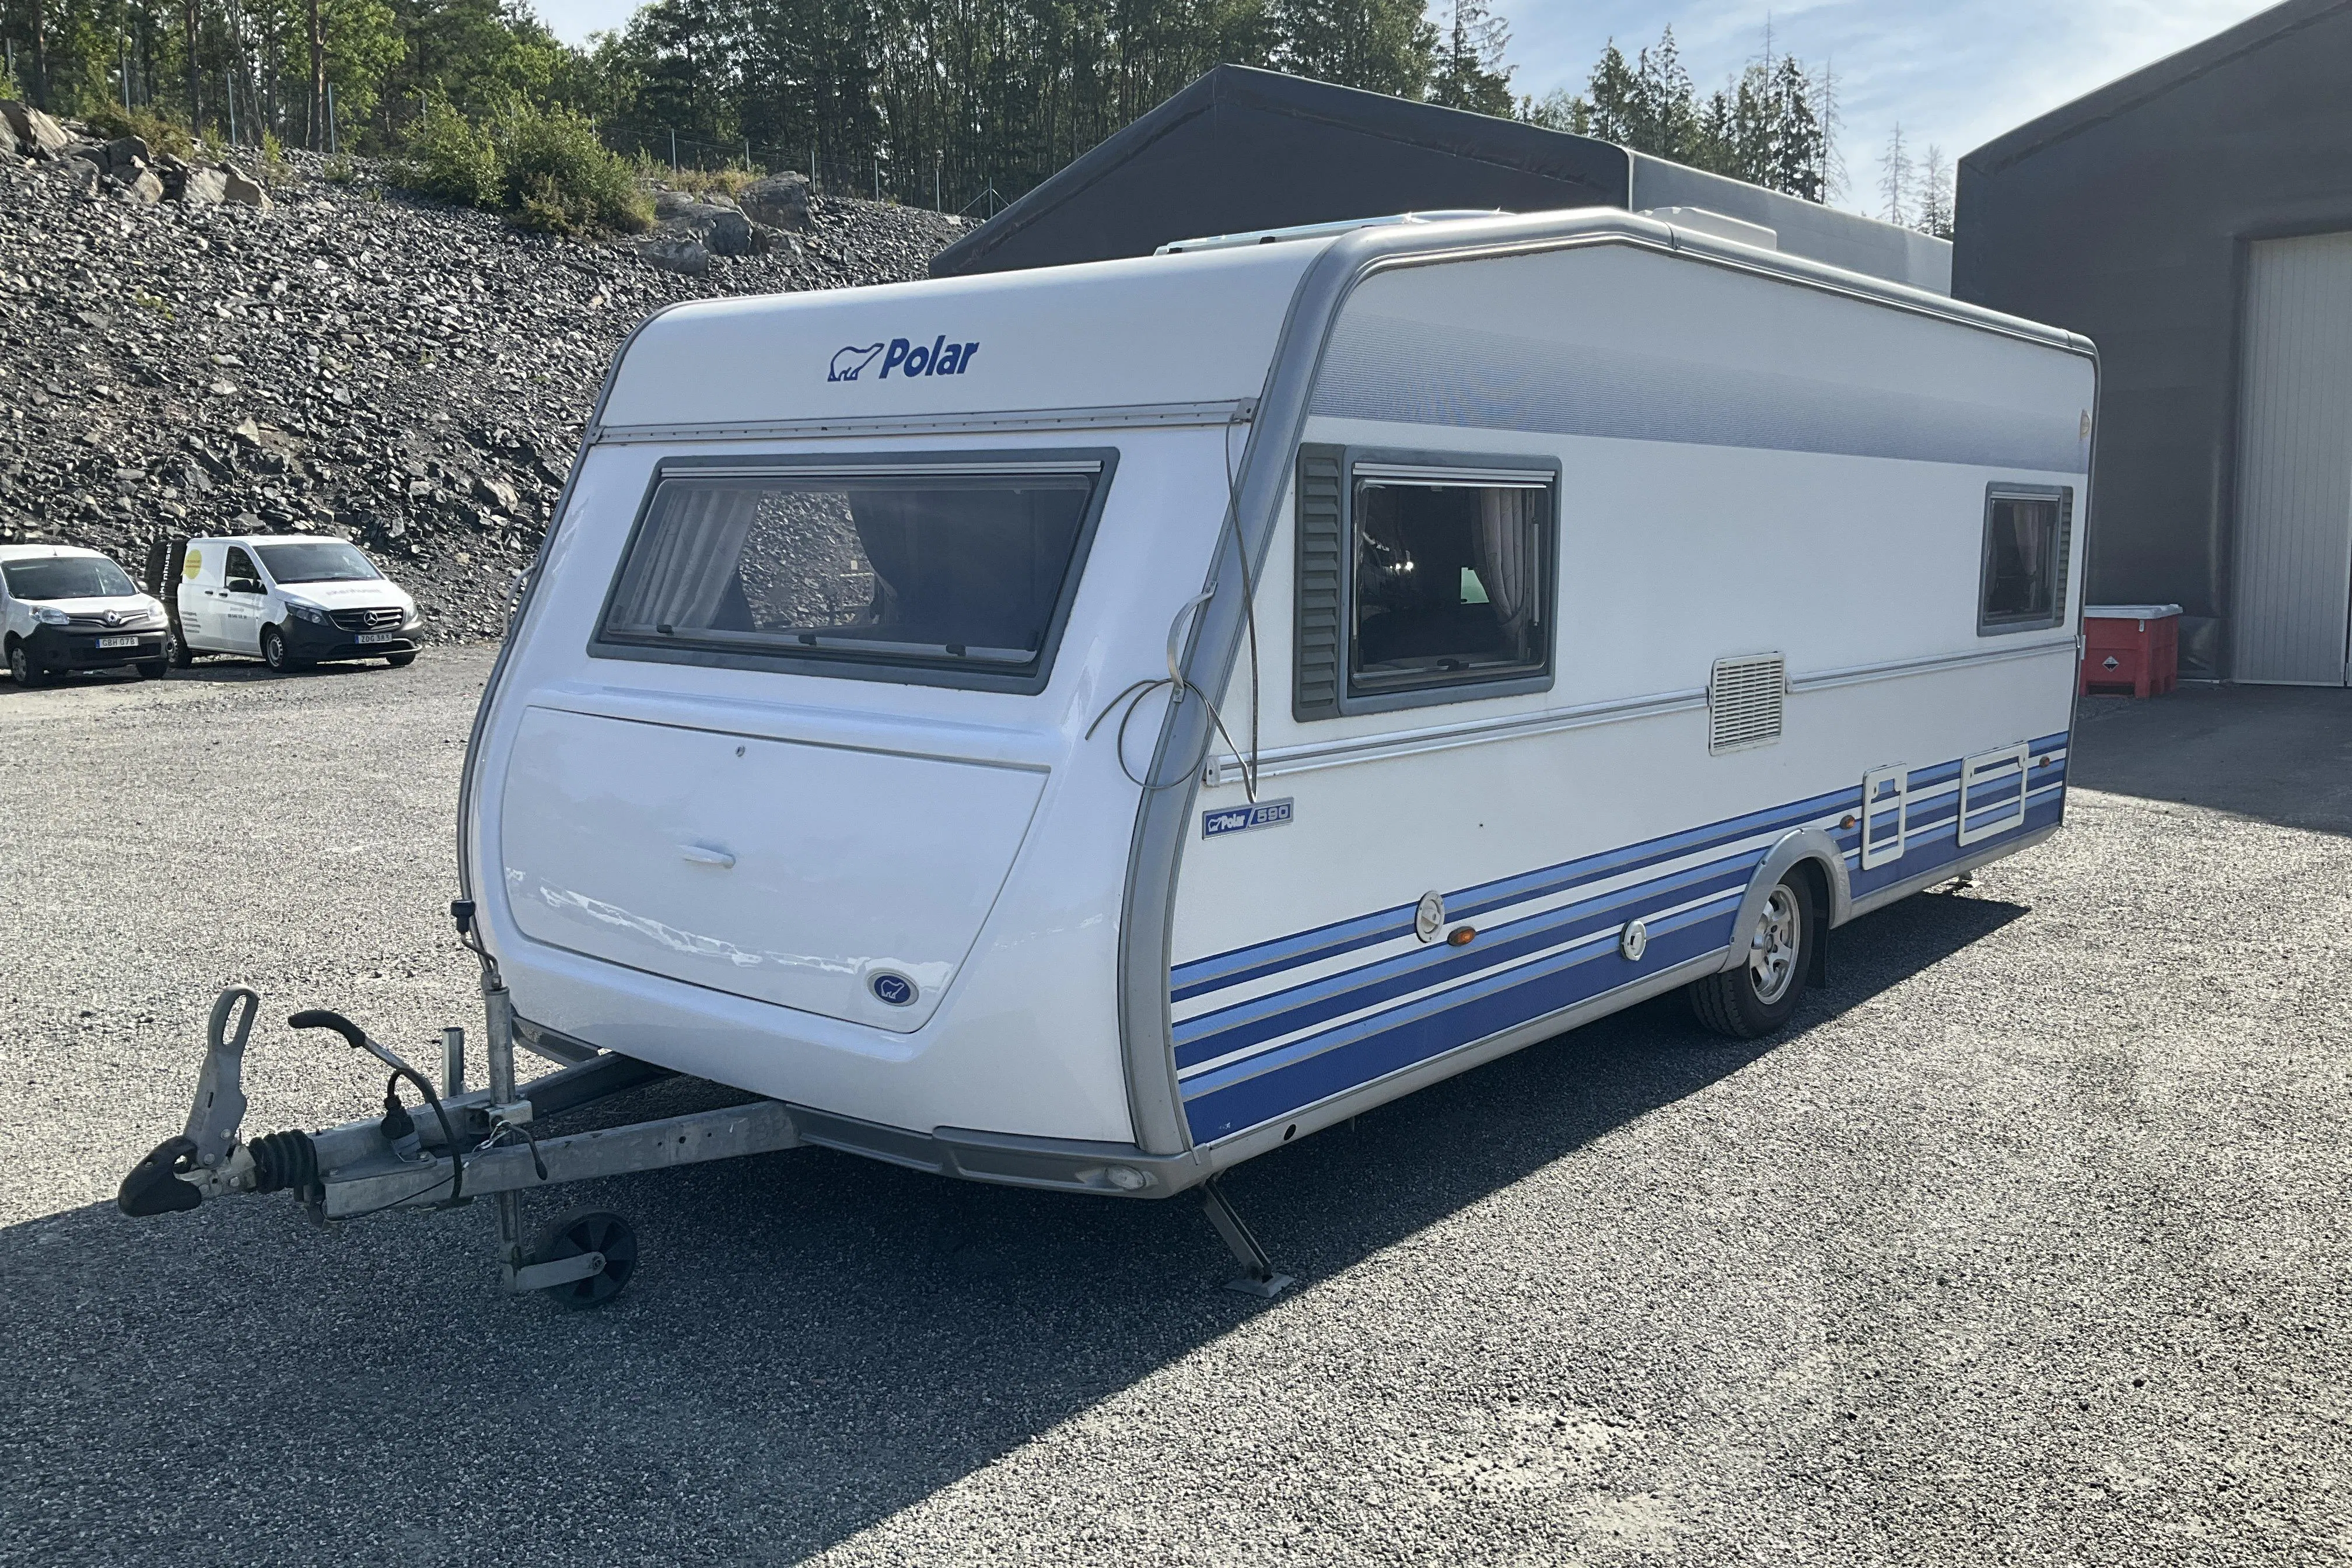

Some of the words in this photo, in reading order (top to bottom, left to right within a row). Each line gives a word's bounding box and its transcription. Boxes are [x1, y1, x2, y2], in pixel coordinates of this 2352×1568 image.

[878, 335, 980, 379] Polar
[1221, 813, 1246, 830] Polar
[1256, 805, 1289, 822] 590
